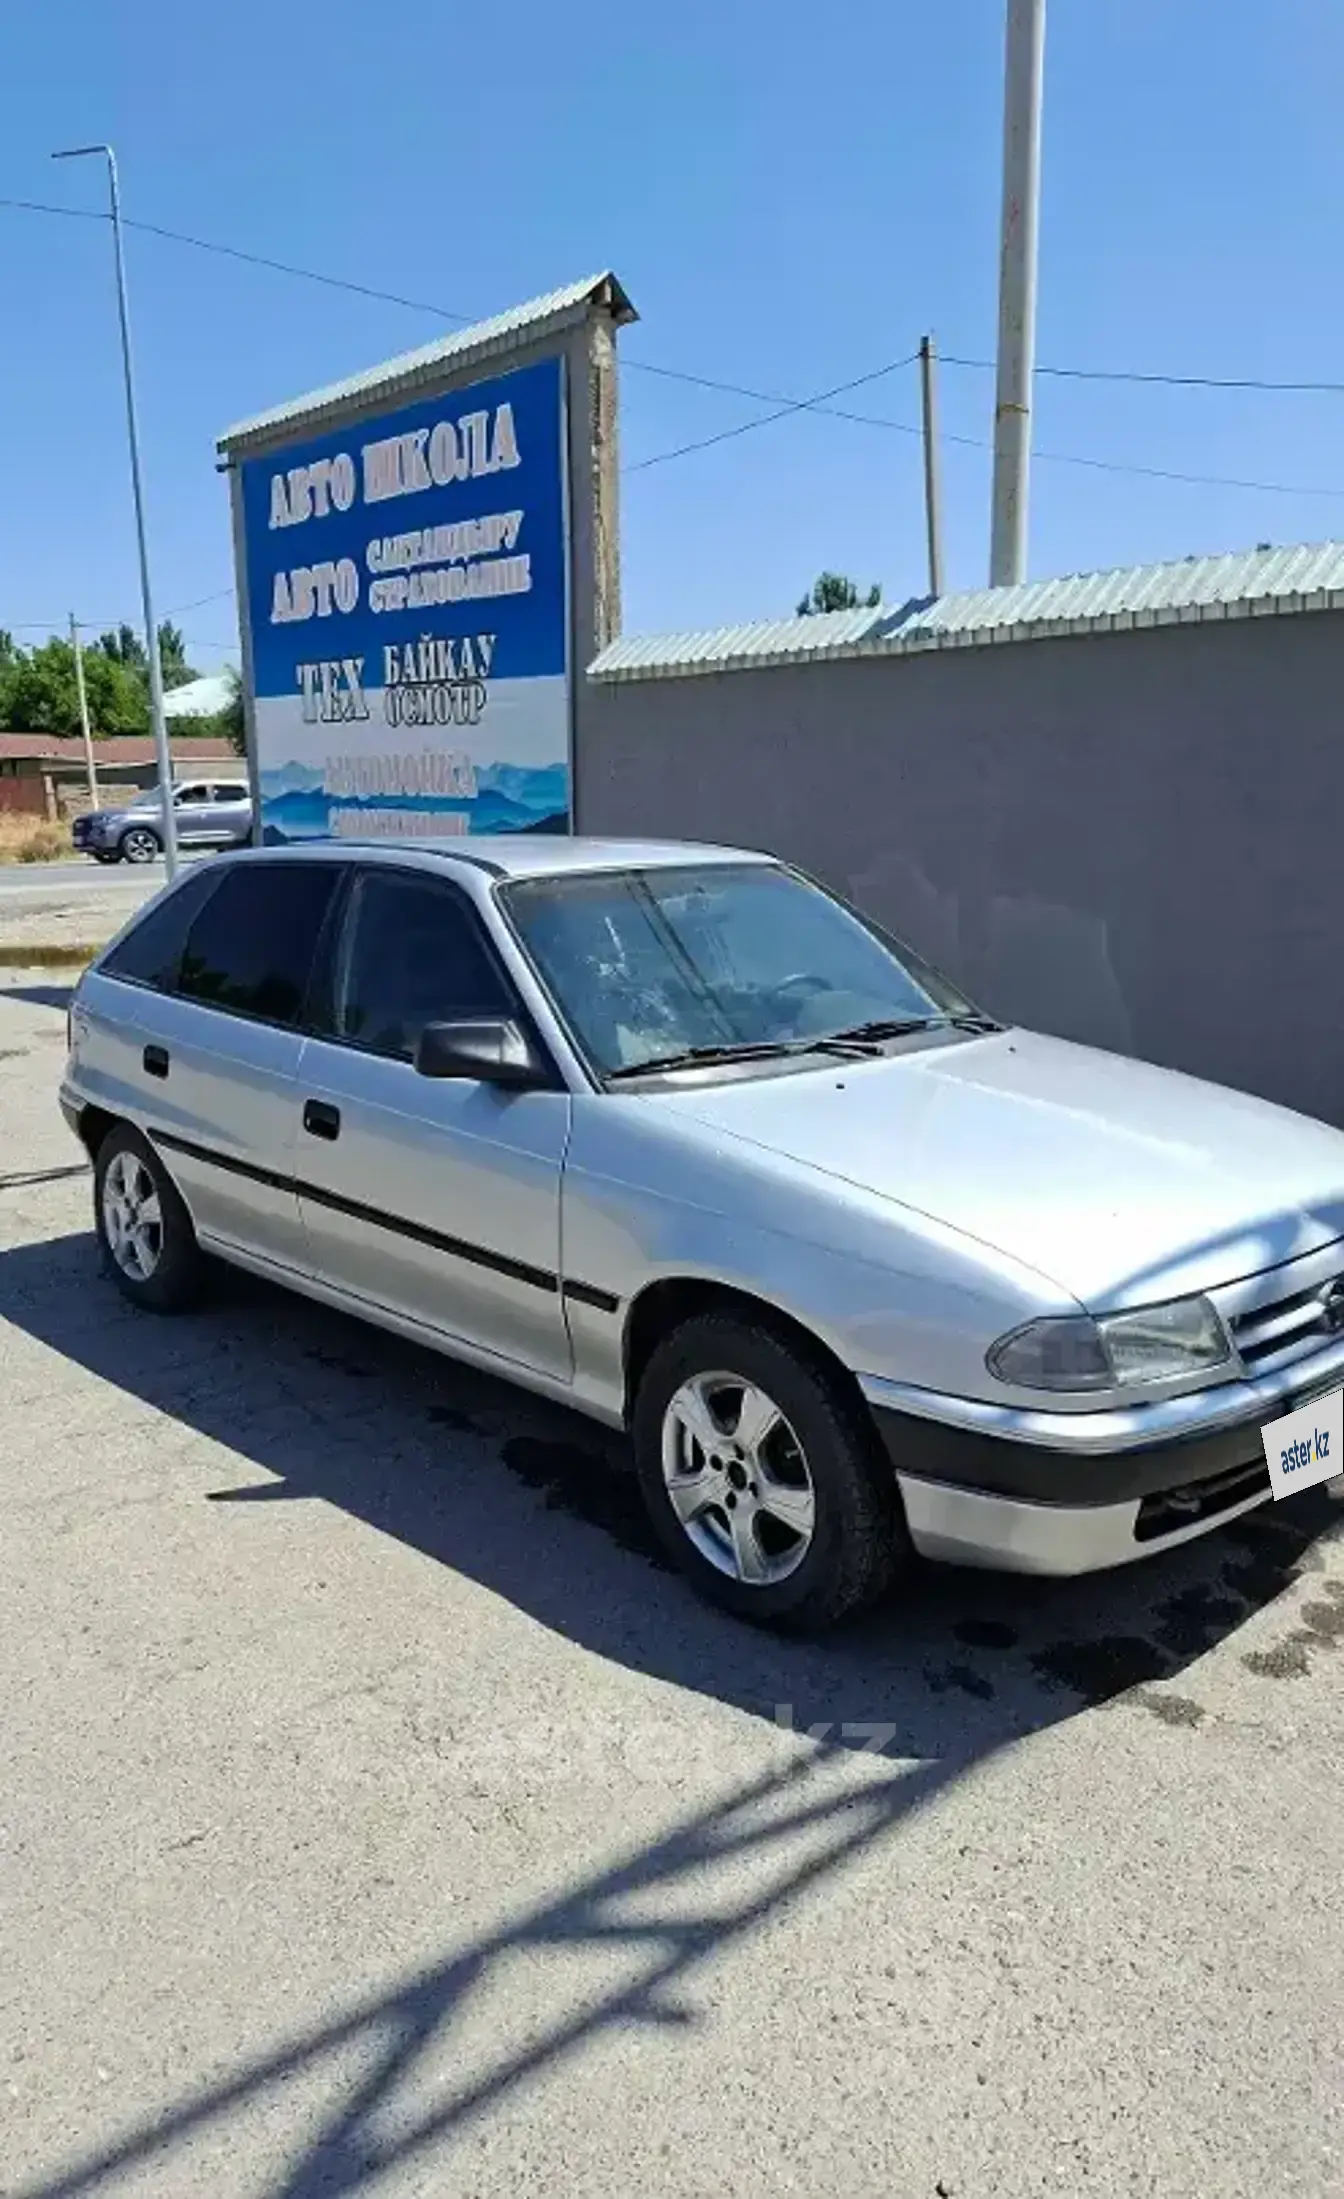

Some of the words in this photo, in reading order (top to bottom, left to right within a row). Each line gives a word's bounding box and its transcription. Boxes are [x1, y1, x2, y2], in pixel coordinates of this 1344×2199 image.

[269, 453, 355, 530] АВТО
[361, 402, 521, 503] ШКОЛА
[270, 558, 359, 624] АВТО
[296, 657, 369, 724] ТЕХ
[384, 682, 487, 727] ОСМОТР
